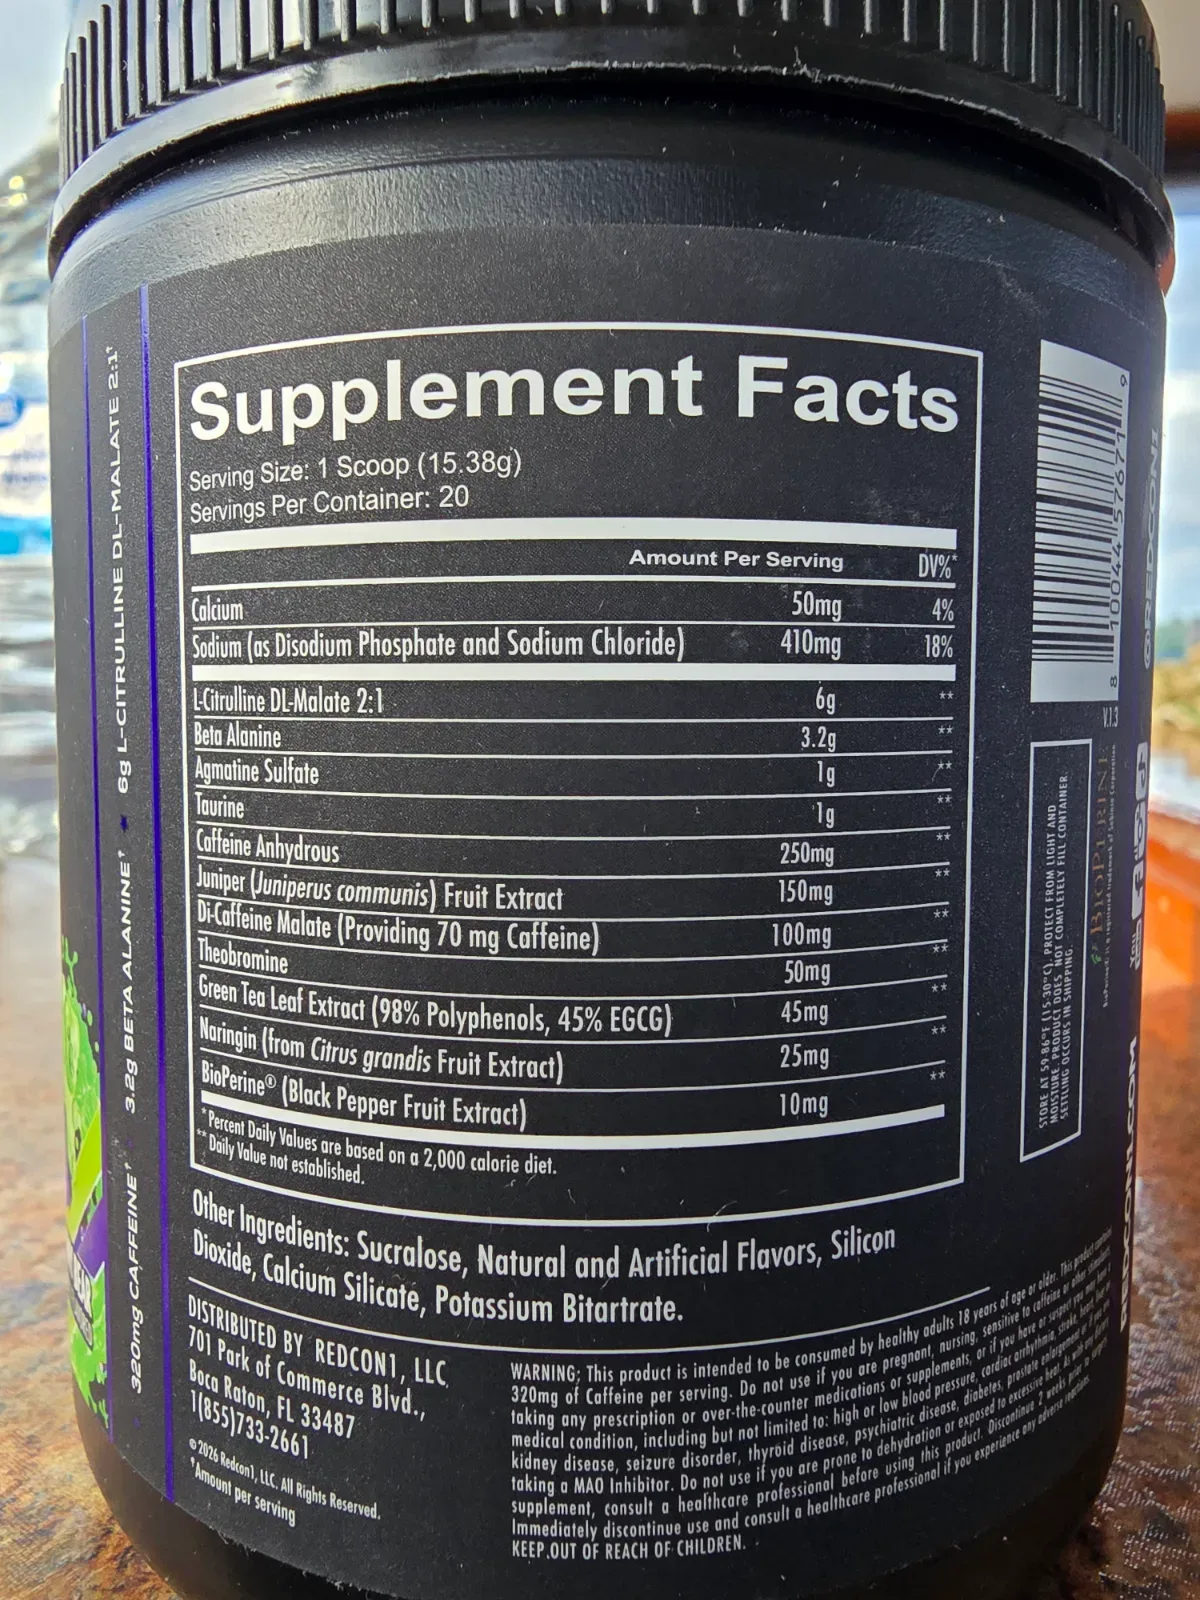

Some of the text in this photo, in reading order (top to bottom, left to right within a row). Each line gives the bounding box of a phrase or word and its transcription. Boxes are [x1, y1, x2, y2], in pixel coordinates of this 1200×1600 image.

[190, 354, 959, 445] Supplement Facts
[107, 396, 123, 559] DL-MALATE
[190, 448, 522, 491] Serving Size: 1 Scoop (15.38g)
[190, 485, 469, 524] Servings Per Container: 20
[1109, 374, 1129, 689] 8 10044 57671 9
[629, 549, 844, 572] Amount Per Serving
[191, 597, 244, 622] Calcium
[792, 591, 842, 622] 50mg
[932, 599, 954, 621] 4%
[112, 566, 128, 752] L-CITRULLINE
[192, 626, 685, 663] Sodium (as Disodium Phosphate and Sodium Chloride)
[781, 629, 842, 660] 410mg
[924, 634, 953, 658] 18%
[194, 686, 383, 714] L-Citrulline DL-Malate 2:1
[815, 686, 836, 715] 6g
[194, 720, 281, 748] Beta Alanine
[801, 726, 836, 753] 3.2g
[117, 760, 131, 794] 6g
[195, 755, 319, 785] Agmatine Sulfate
[817, 760, 835, 787] 1g
[195, 791, 244, 818] Taurine
[817, 801, 834, 829] 1g
[1046, 805, 1057, 828] AND
[197, 828, 340, 865] Caffeine Anhydrous
[780, 842, 834, 867] 250mg
[1045, 833, 1056, 866] LIGHT
[196, 864, 563, 913] Juniper (Juniperus communis) Fruit Extract
[779, 879, 834, 906] 150mg
[1045, 870, 1055, 902] FROM
[197, 898, 600, 956] Di-Caffeine Malate (Providing 70 mg Caffeine)
[772, 922, 832, 949] 100mg
[1044, 907, 1055, 954] PROTECT
[198, 937, 288, 974] Theobromine
[784, 960, 831, 986] 50mg
[122, 985, 135, 1053] BETA
[199, 973, 672, 1038] Green Tea Leaf Extract (98% Polyphenols, 45% EGCG)
[781, 1000, 829, 1025] 45mg
[199, 1015, 563, 1085] Naringin (from Citrus grandis Fruit Extract)
[780, 1044, 829, 1070] 25mg
[124, 1059, 139, 1115] 3.2g
[1040, 1077, 1050, 1089] AT
[282, 1075, 331, 1108] (Black
[336, 1086, 397, 1119] Pepper
[403, 1093, 445, 1121] Fruit
[452, 1097, 527, 1132] Extract)
[780, 1092, 829, 1118] 10mg
[1038, 1093, 1049, 1129] STORE
[237, 1139, 266, 1165] Value
[270, 1152, 288, 1170] not
[291, 1156, 365, 1186] established.
[248, 1120, 276, 1147] Daily
[278, 1130, 318, 1152] Values
[321, 1139, 342, 1155] are
[345, 1139, 384, 1163] based
[388, 1148, 406, 1164] on
[410, 1152, 419, 1166] a
[423, 1148, 466, 1171] 2,000
[470, 1152, 520, 1174] calorie
[524, 1153, 558, 1175] diet.
[193, 1188, 896, 1280] Other Ingredients: Sucralose, Natural and Artificial Flavors, Silicon
[193, 1228, 684, 1323] Dioxide, Calcium Silicate, Potassium Bitartrate.
[130, 1305, 144, 1394] 320mg
[188, 1294, 277, 1349] DISTRIBUTED
[283, 1329, 303, 1357] BY
[315, 1338, 405, 1385] REDCON1,
[586, 1364, 614, 1382] This
[619, 1362, 671, 1386] product
[677, 1363, 688, 1380] is
[693, 1355, 751, 1378] intended
[757, 1357, 770, 1372] to
[775, 1352, 790, 1369] be
[795, 1339, 855, 1367] consumed
[860, 1337, 874, 1357] by
[878, 1325, 919, 1350] healthy
[188, 1325, 425, 1422] 701 Park of Commerce Blvd.,
[189, 1358, 356, 1439] Boca Raton, FL 33487
[190, 1389, 309, 1460] 1(855)733-2661
